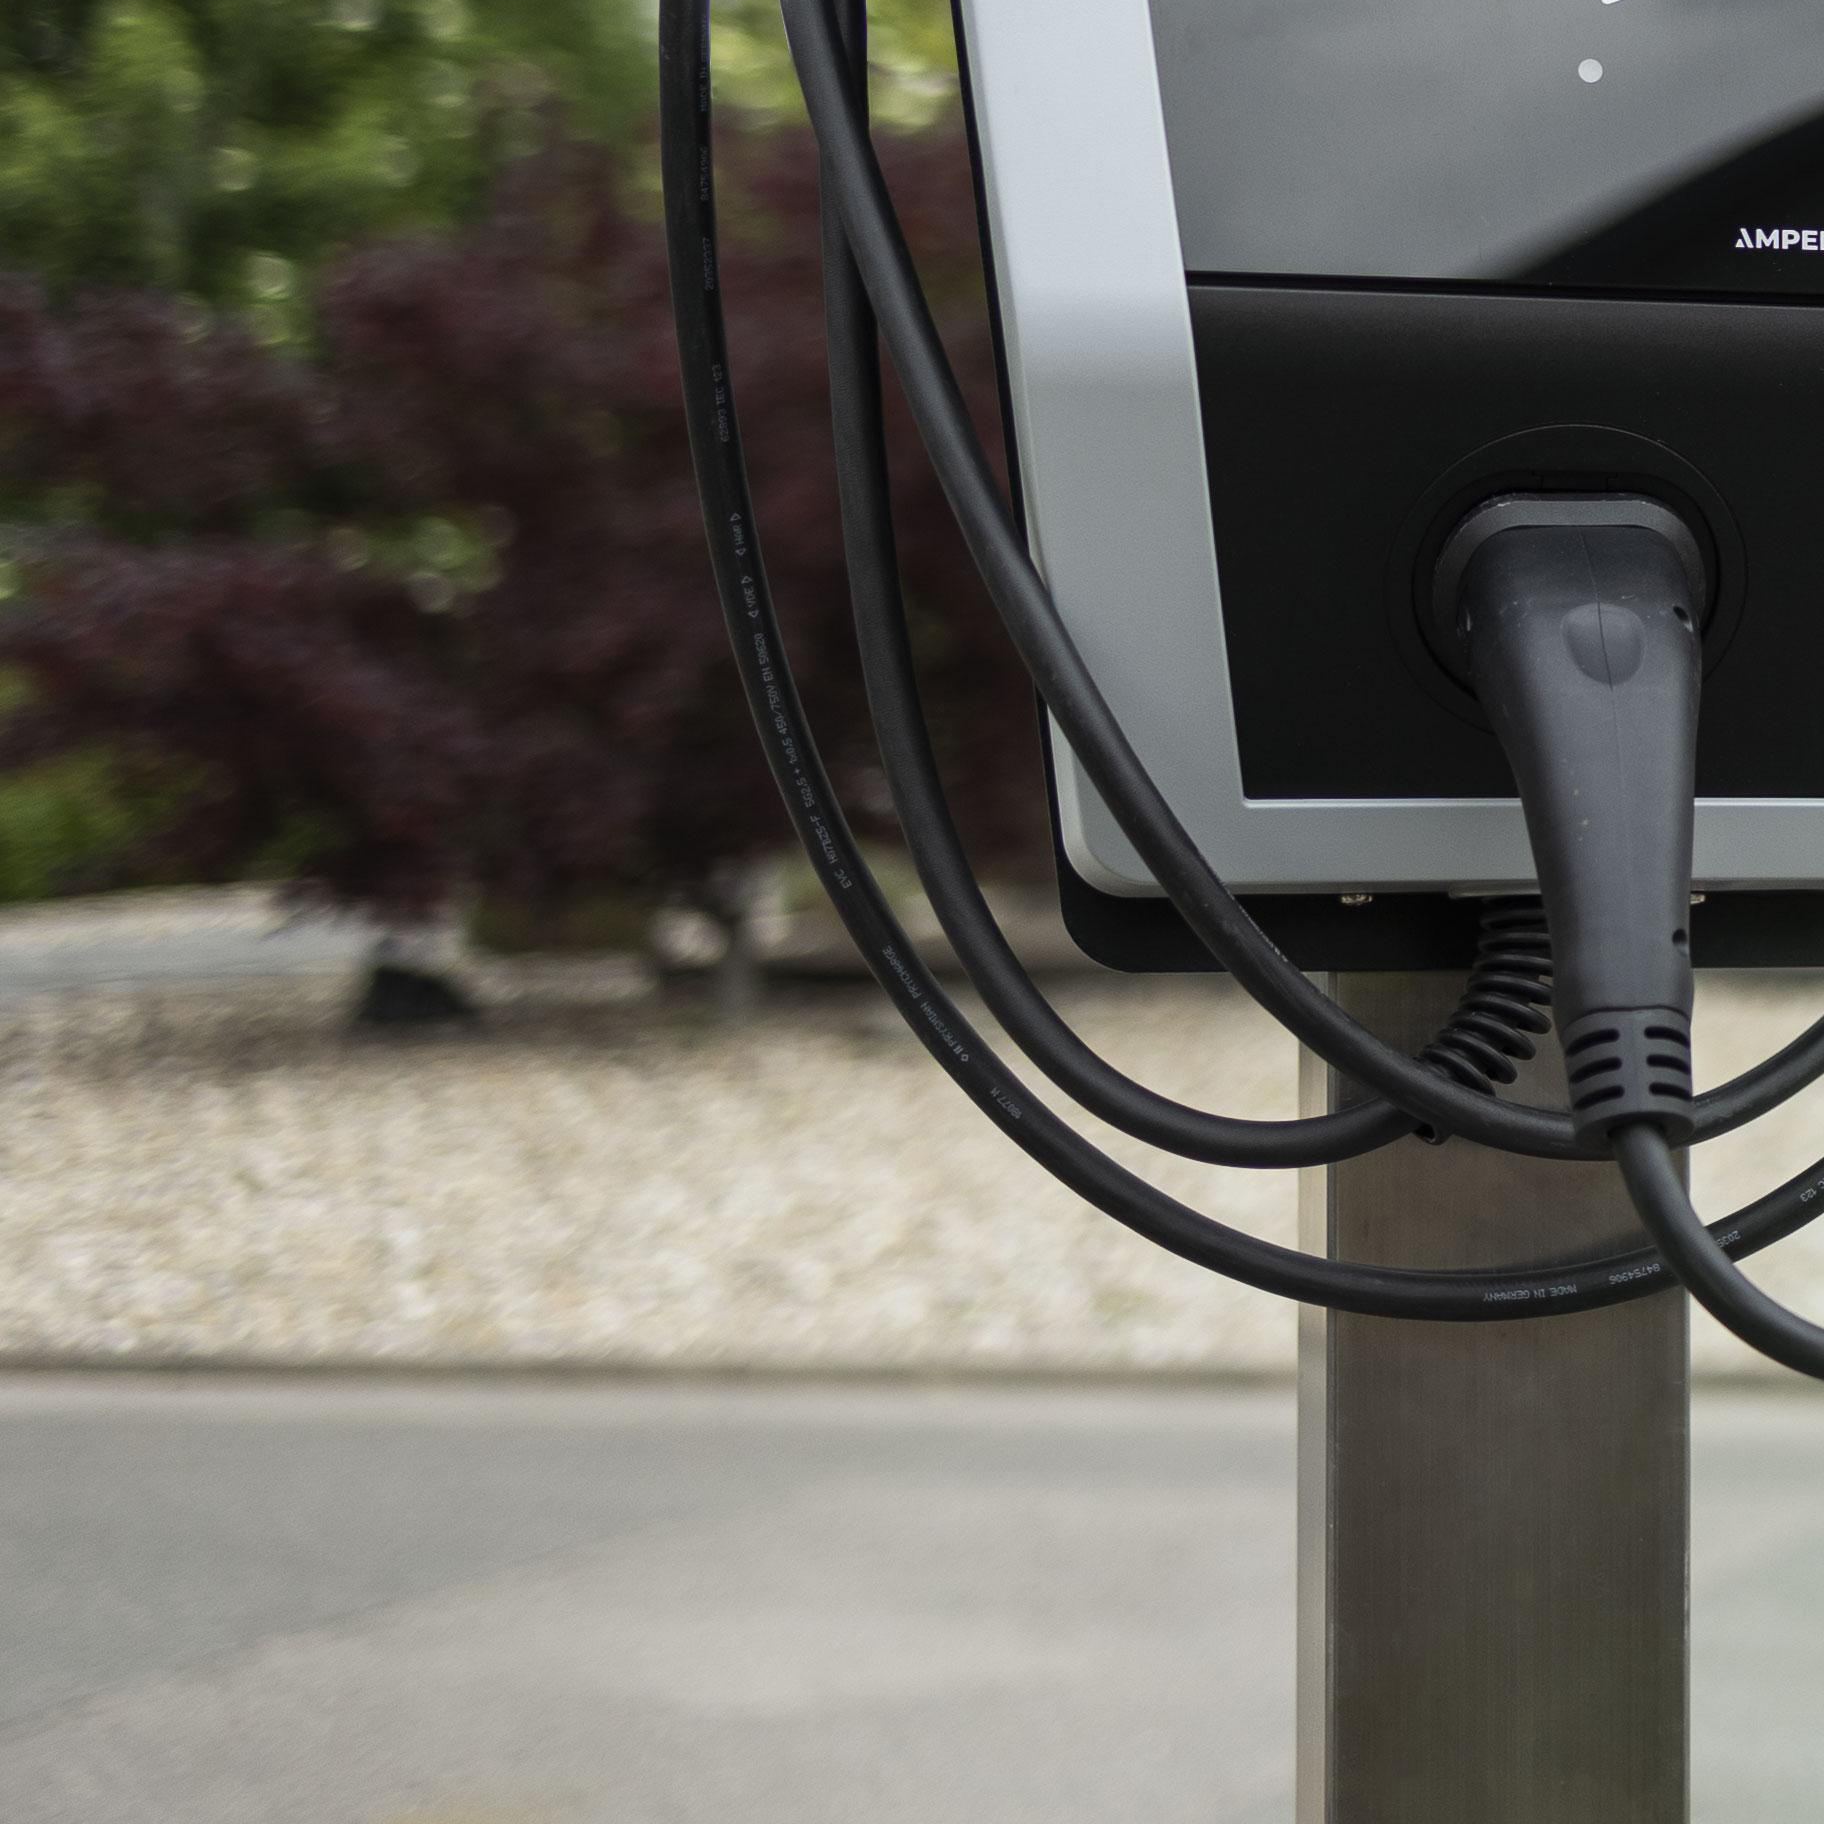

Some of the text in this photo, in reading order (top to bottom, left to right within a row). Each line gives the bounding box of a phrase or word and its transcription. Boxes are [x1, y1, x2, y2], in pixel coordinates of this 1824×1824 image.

[712, 362, 730, 442] 62893 IEC 123
[733, 523, 745, 544] HAR
[744, 585, 757, 606] VDE
[753, 631, 770, 664] 50620
[762, 665, 775, 681] EN
[766, 682, 789, 735] 450/750V
[832, 865, 853, 890] EVC
[880, 943, 958, 1048] PRYSMIAN PRYCHARGE
[1799, 1186, 1819, 1203] 123
[1607, 1261, 1661, 1285] 84754906
[1482, 1283, 1578, 1303] MADE IN GERMANY
